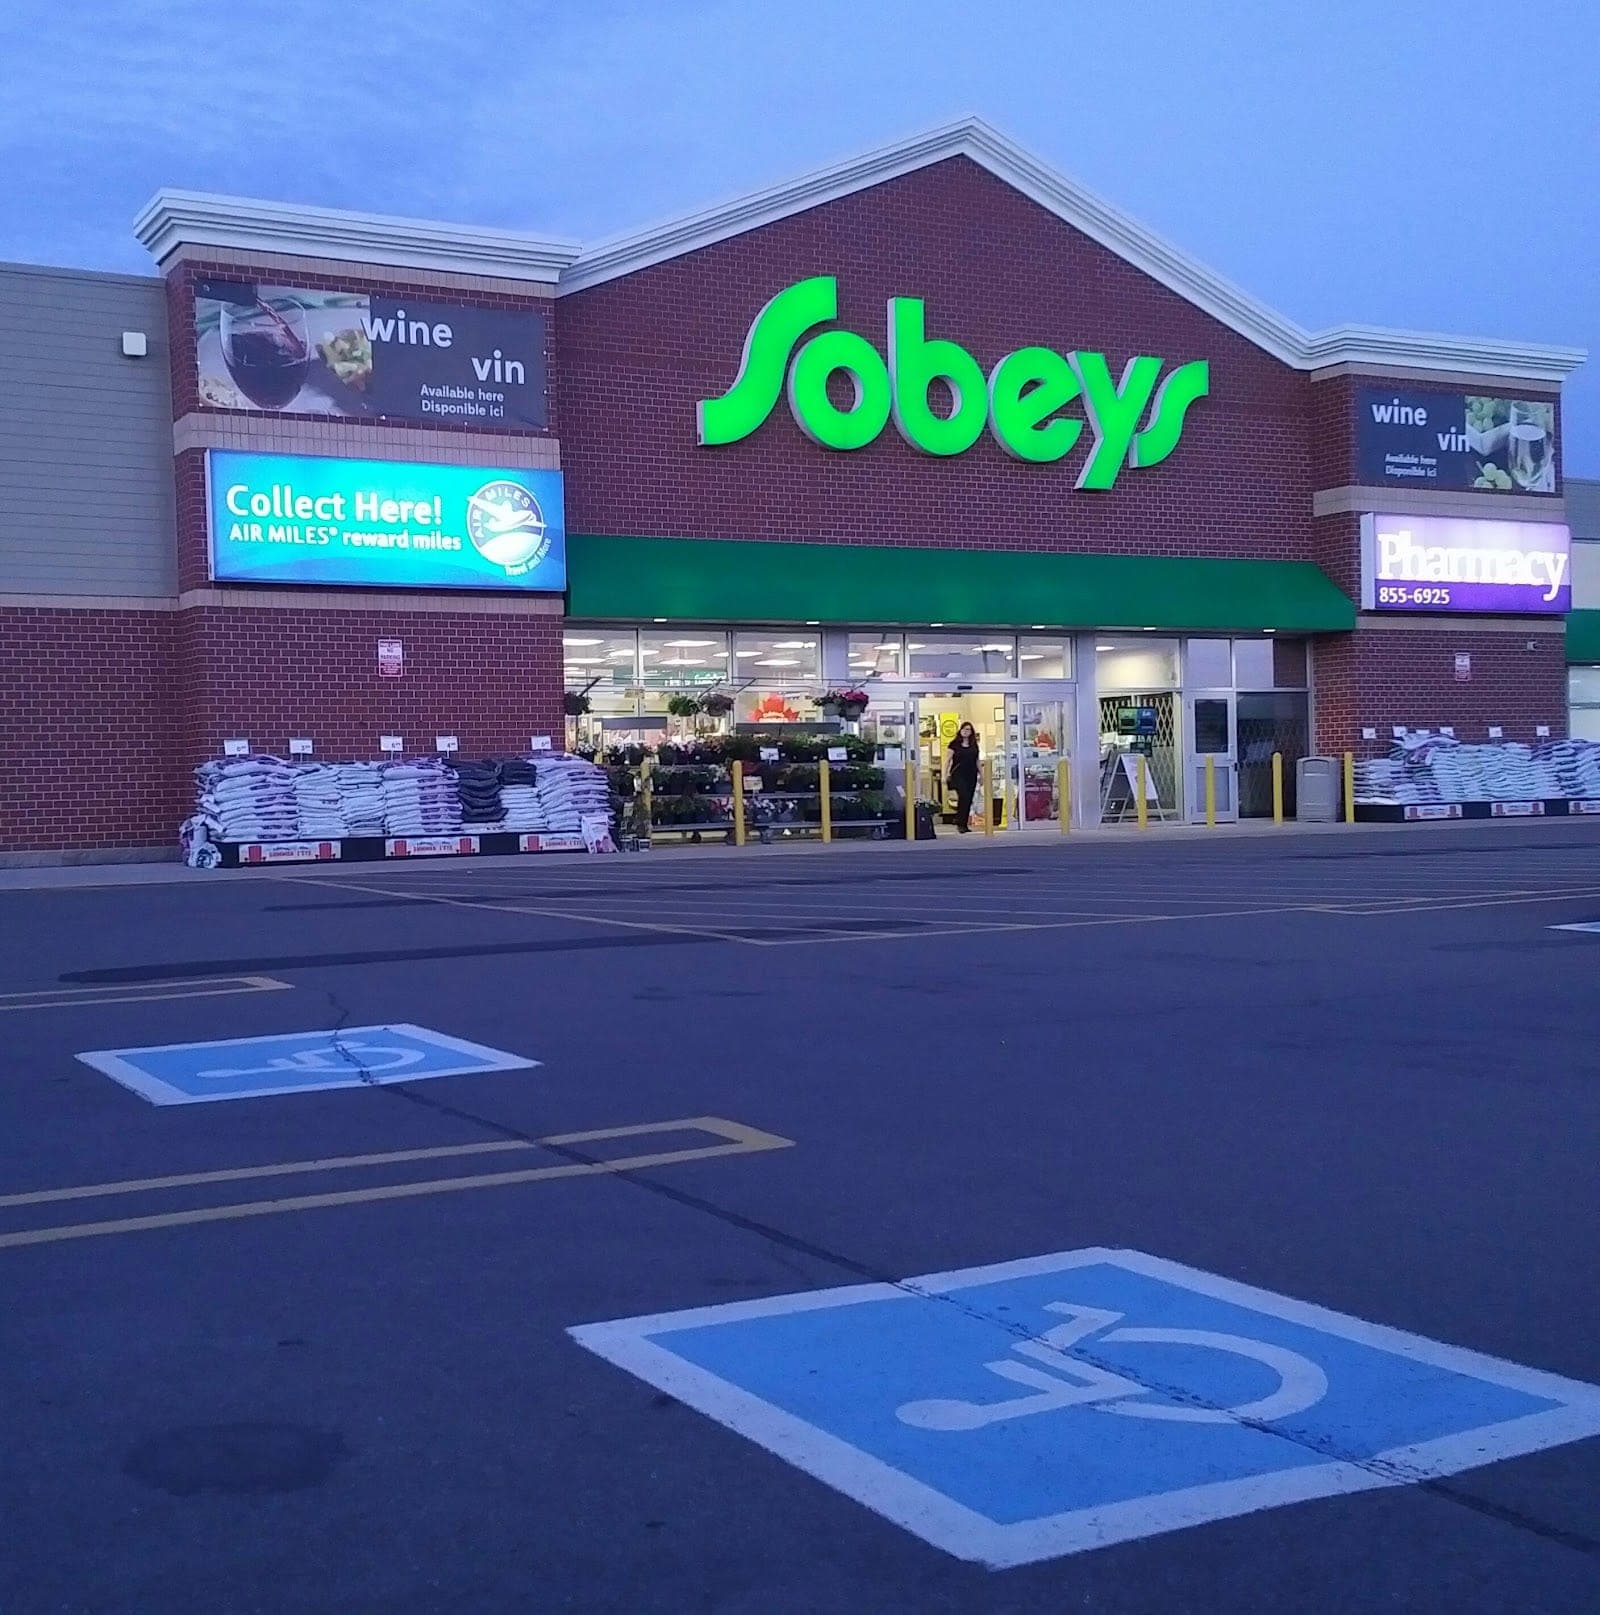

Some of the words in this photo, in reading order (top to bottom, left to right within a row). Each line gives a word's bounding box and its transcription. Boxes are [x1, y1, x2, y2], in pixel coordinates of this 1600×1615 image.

[361, 310, 453, 347] wine
[471, 350, 525, 384] vin
[421, 384, 474, 399] Available
[478, 388, 504, 401] here
[697, 276, 1209, 490] Sobeys
[421, 400, 486, 416] Disponible
[490, 405, 504, 417] ici
[1372, 398, 1427, 426] wine
[1437, 427, 1470, 453] vin
[226, 484, 346, 520] Collect
[355, 491, 442, 525] Here!
[485, 487, 530, 508] MILES
[229, 523, 264, 542] AIR
[343, 529, 409, 548] reward
[413, 531, 462, 550] miles
[1378, 530, 1567, 602] Pharmacy
[1379, 586, 1450, 605] 855-6925
